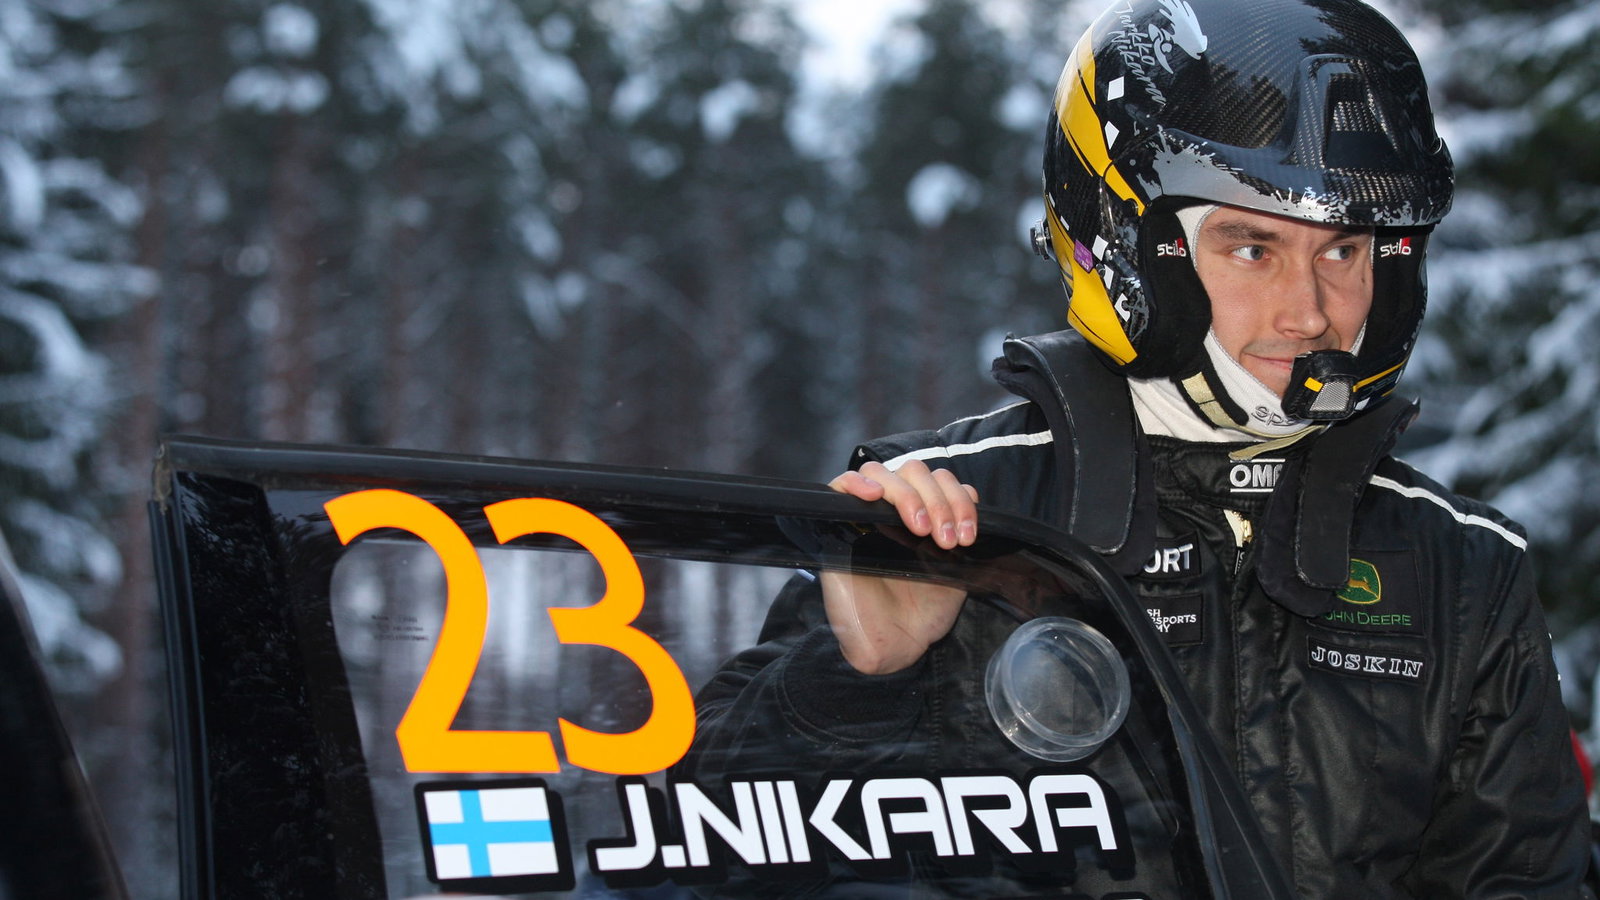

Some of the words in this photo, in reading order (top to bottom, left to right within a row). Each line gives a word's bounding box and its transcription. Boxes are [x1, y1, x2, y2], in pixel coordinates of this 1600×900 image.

[1157, 239, 1187, 257] stilo
[1380, 238, 1412, 258] stilo
[323, 488, 697, 775] 23
[1356, 611, 1412, 626] DEERE
[1311, 645, 1424, 678] JOSKIN
[596, 773, 1118, 871] J.NIKARA
